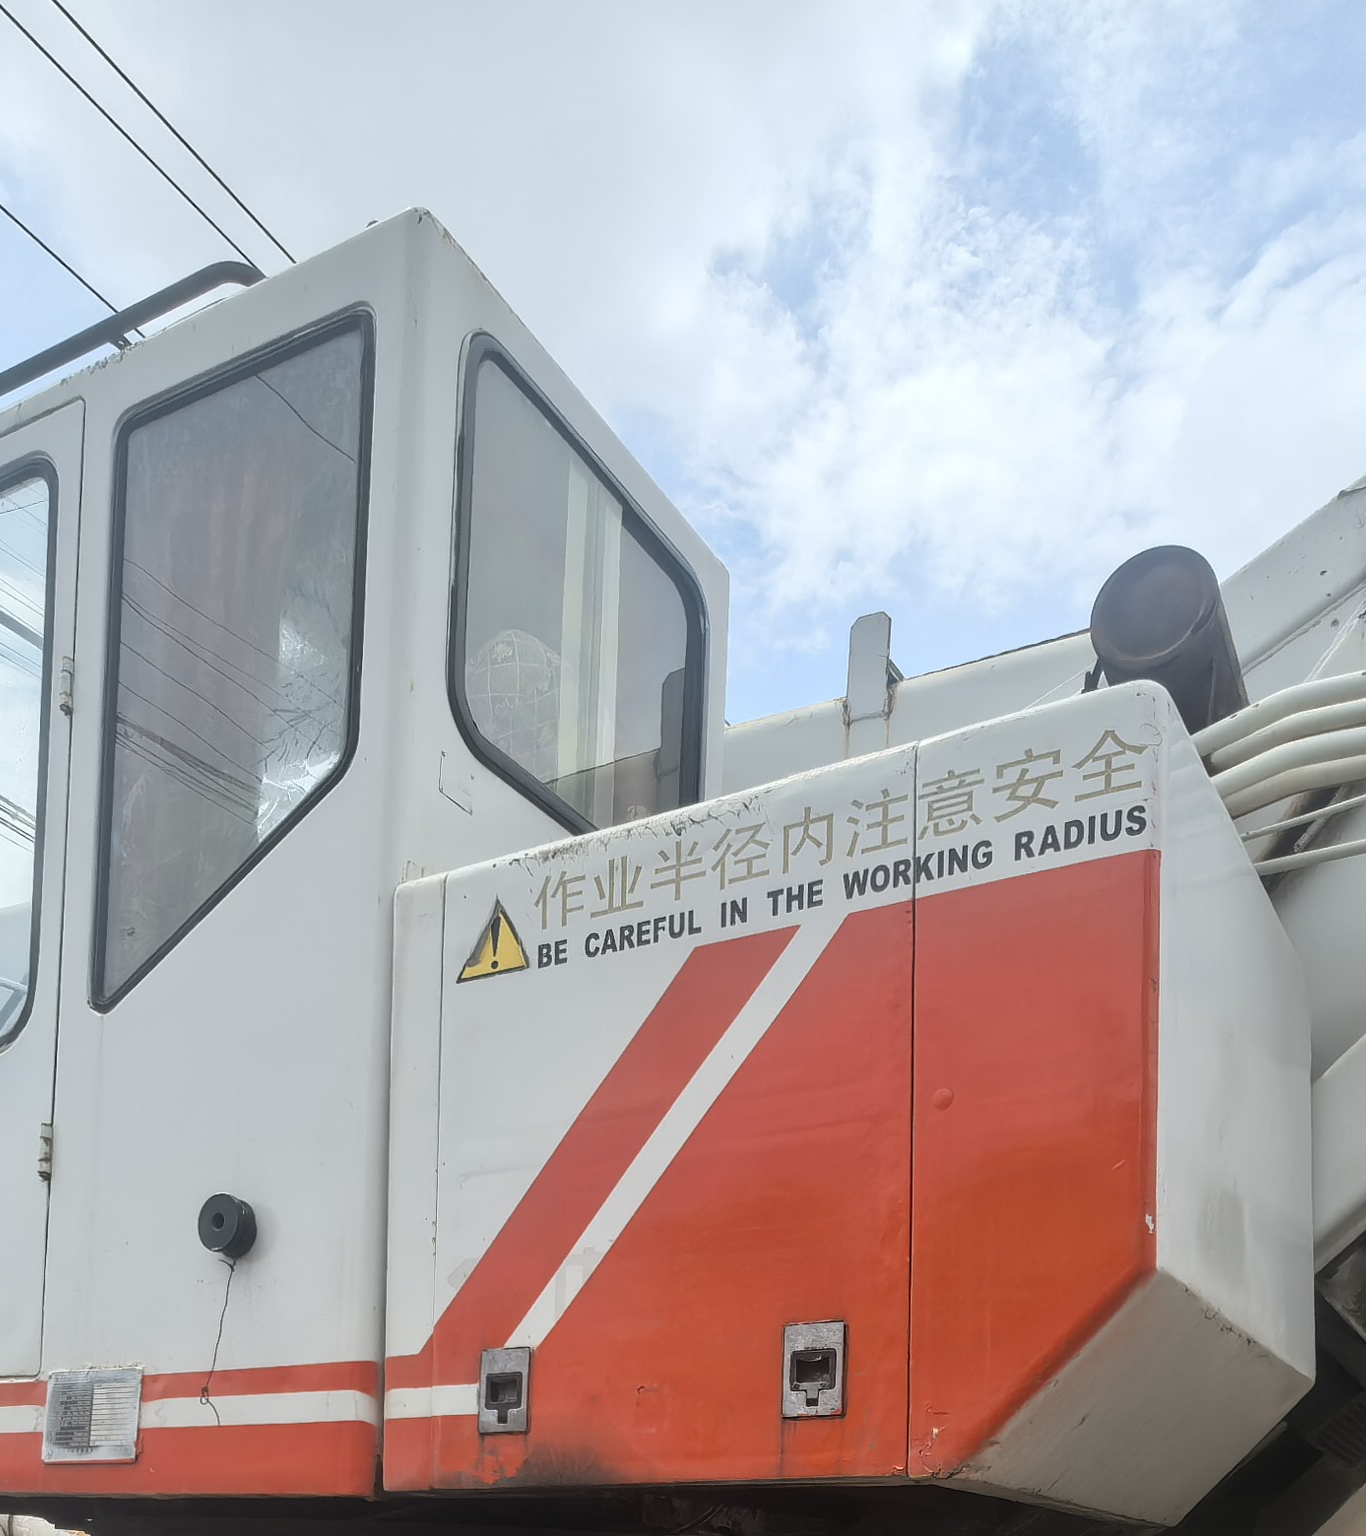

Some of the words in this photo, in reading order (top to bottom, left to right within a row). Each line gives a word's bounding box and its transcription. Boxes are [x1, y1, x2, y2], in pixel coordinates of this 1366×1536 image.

[534, 729, 1149, 930] 作业半径内注意安全
[538, 939, 568, 969] BE
[585, 910, 702, 958] CAREFUL
[720, 896, 748, 928] IN
[767, 879, 824, 917] THE
[843, 840, 994, 900] WORKING
[1014, 804, 1148, 862] RADIUS
